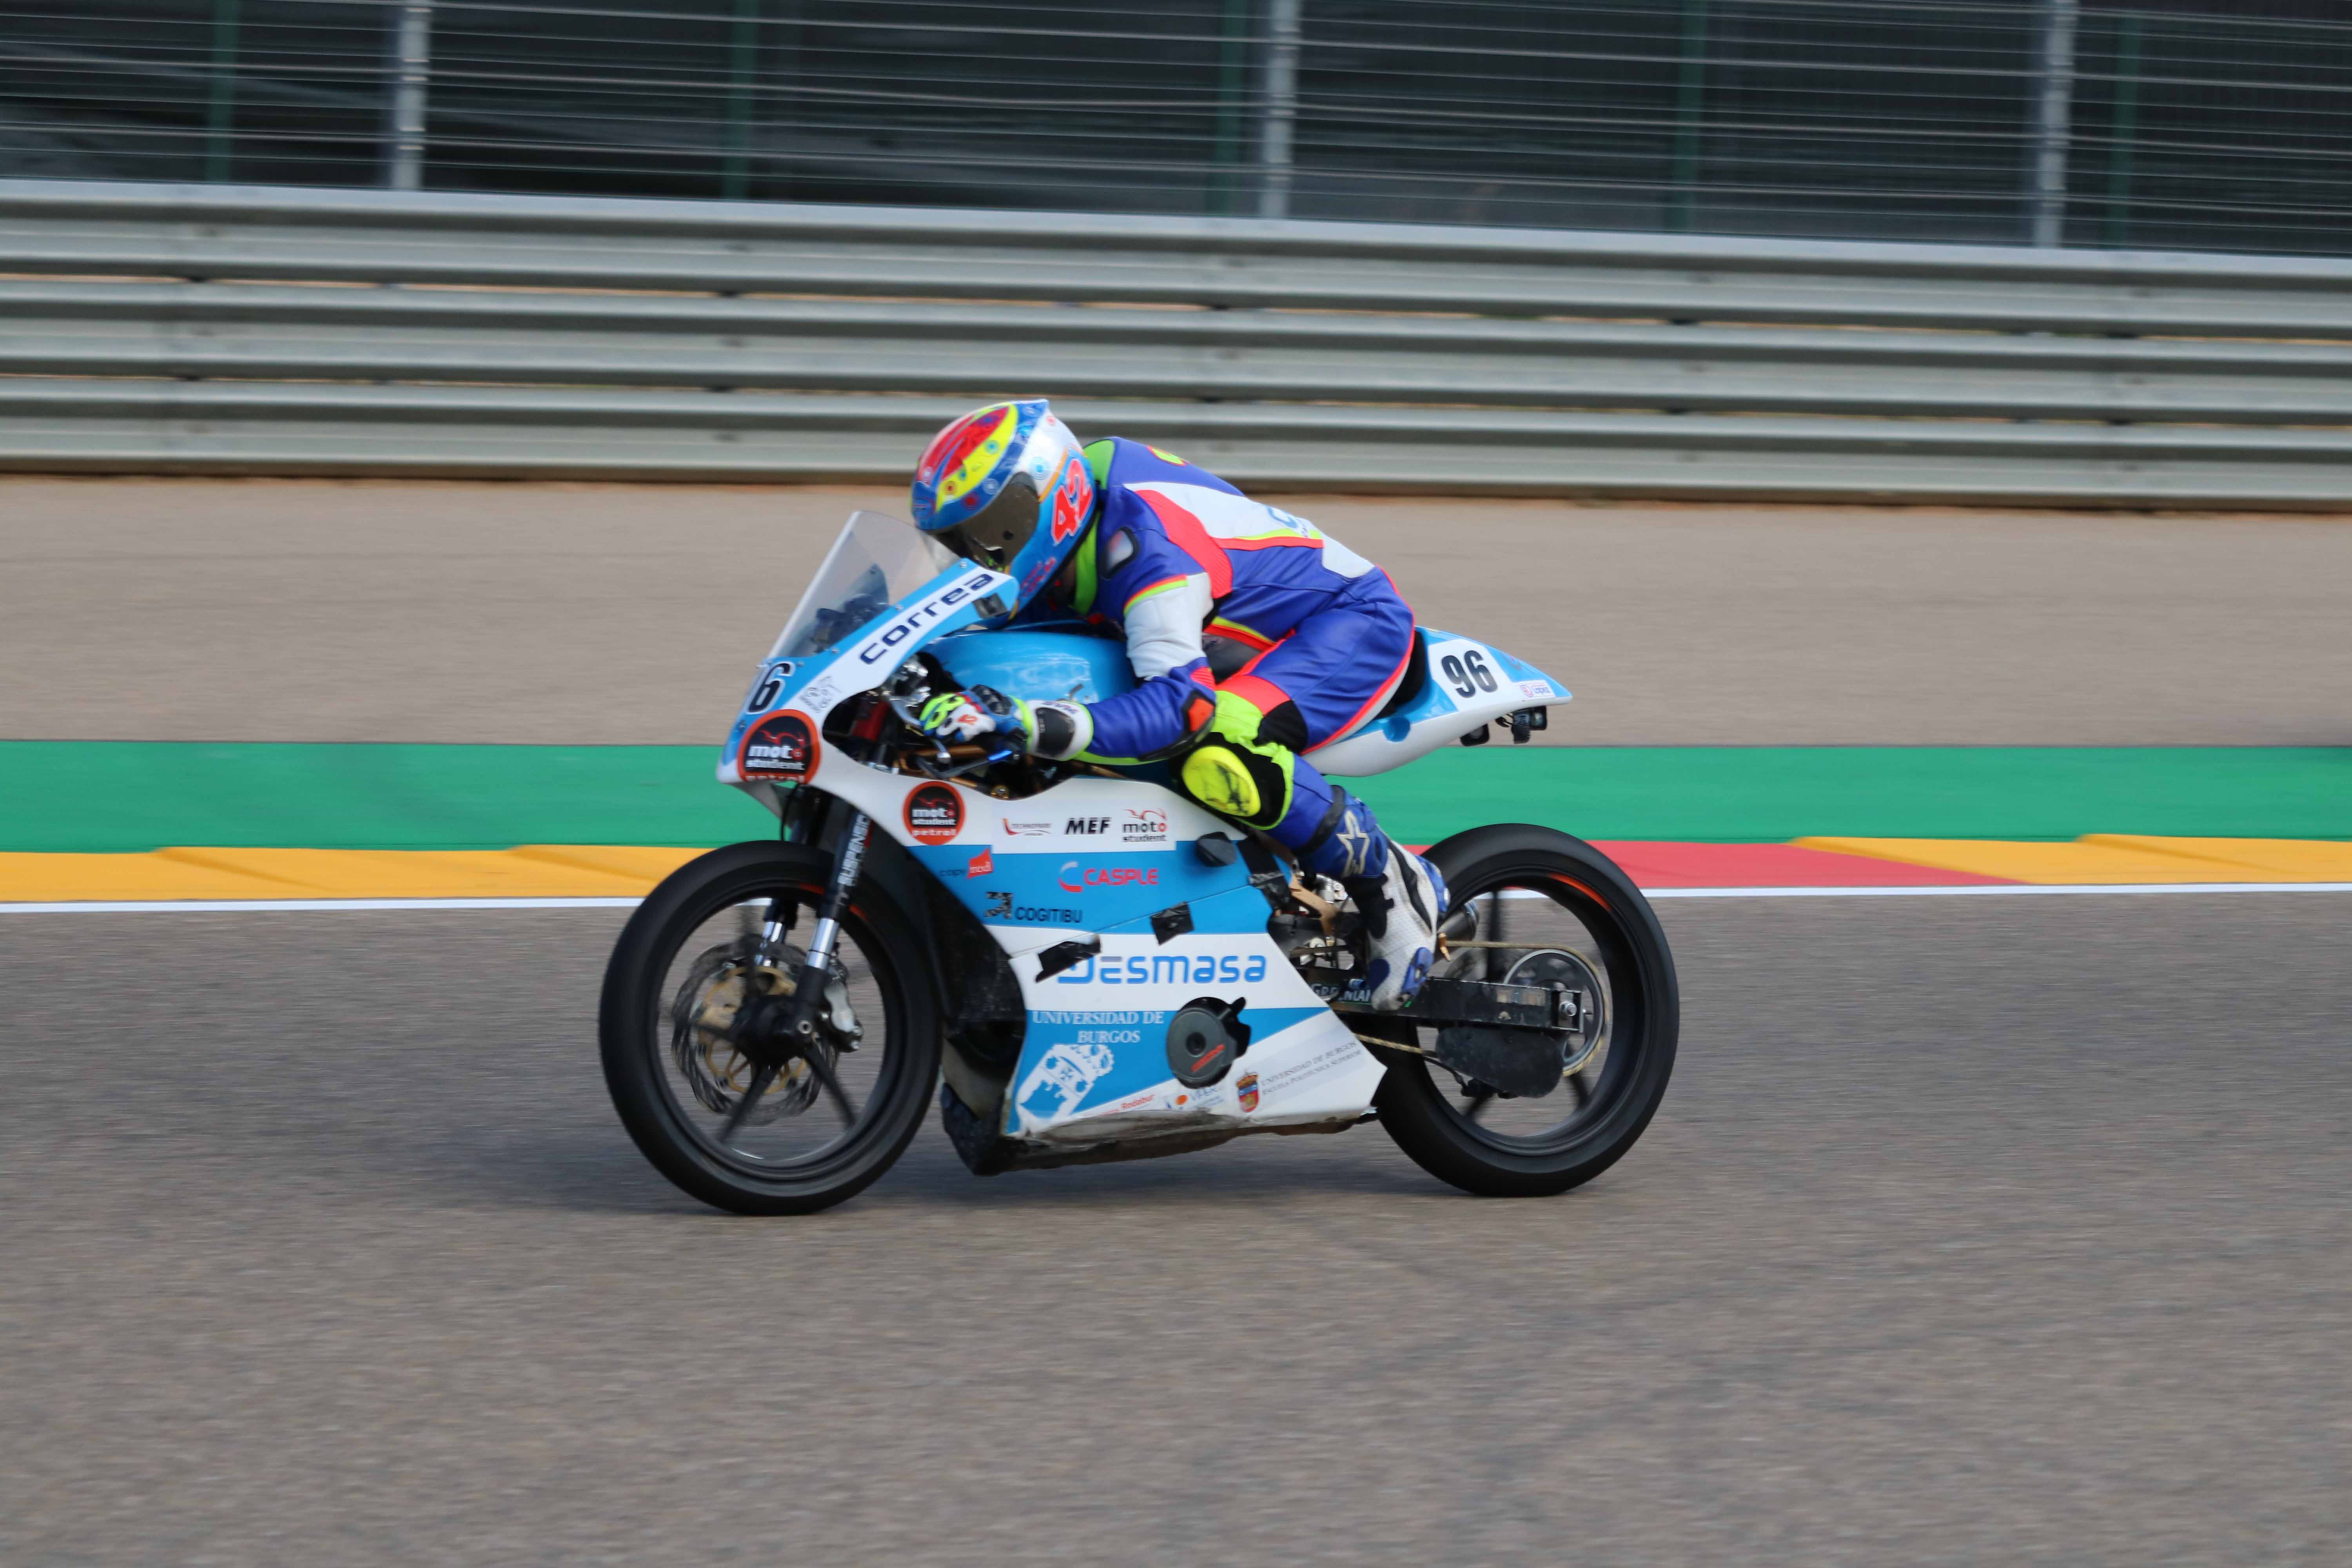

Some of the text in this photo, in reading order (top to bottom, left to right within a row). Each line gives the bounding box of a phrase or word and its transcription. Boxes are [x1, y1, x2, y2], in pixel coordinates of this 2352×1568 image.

[1051, 458, 1094, 545] 42
[859, 573, 994, 664] correa
[1441, 650, 1498, 698] 96
[746, 662, 794, 714] 6
[745, 759, 806, 770] student
[1065, 817, 1112, 835] MEF
[1123, 822, 1167, 833] moto
[1083, 868, 1159, 886] CASPLE
[1014, 907, 1083, 924] COGITIBU
[1032, 1011, 1165, 1024] UNIVERSIDAD DE
[1077, 1030, 1141, 1043] BURGOS
